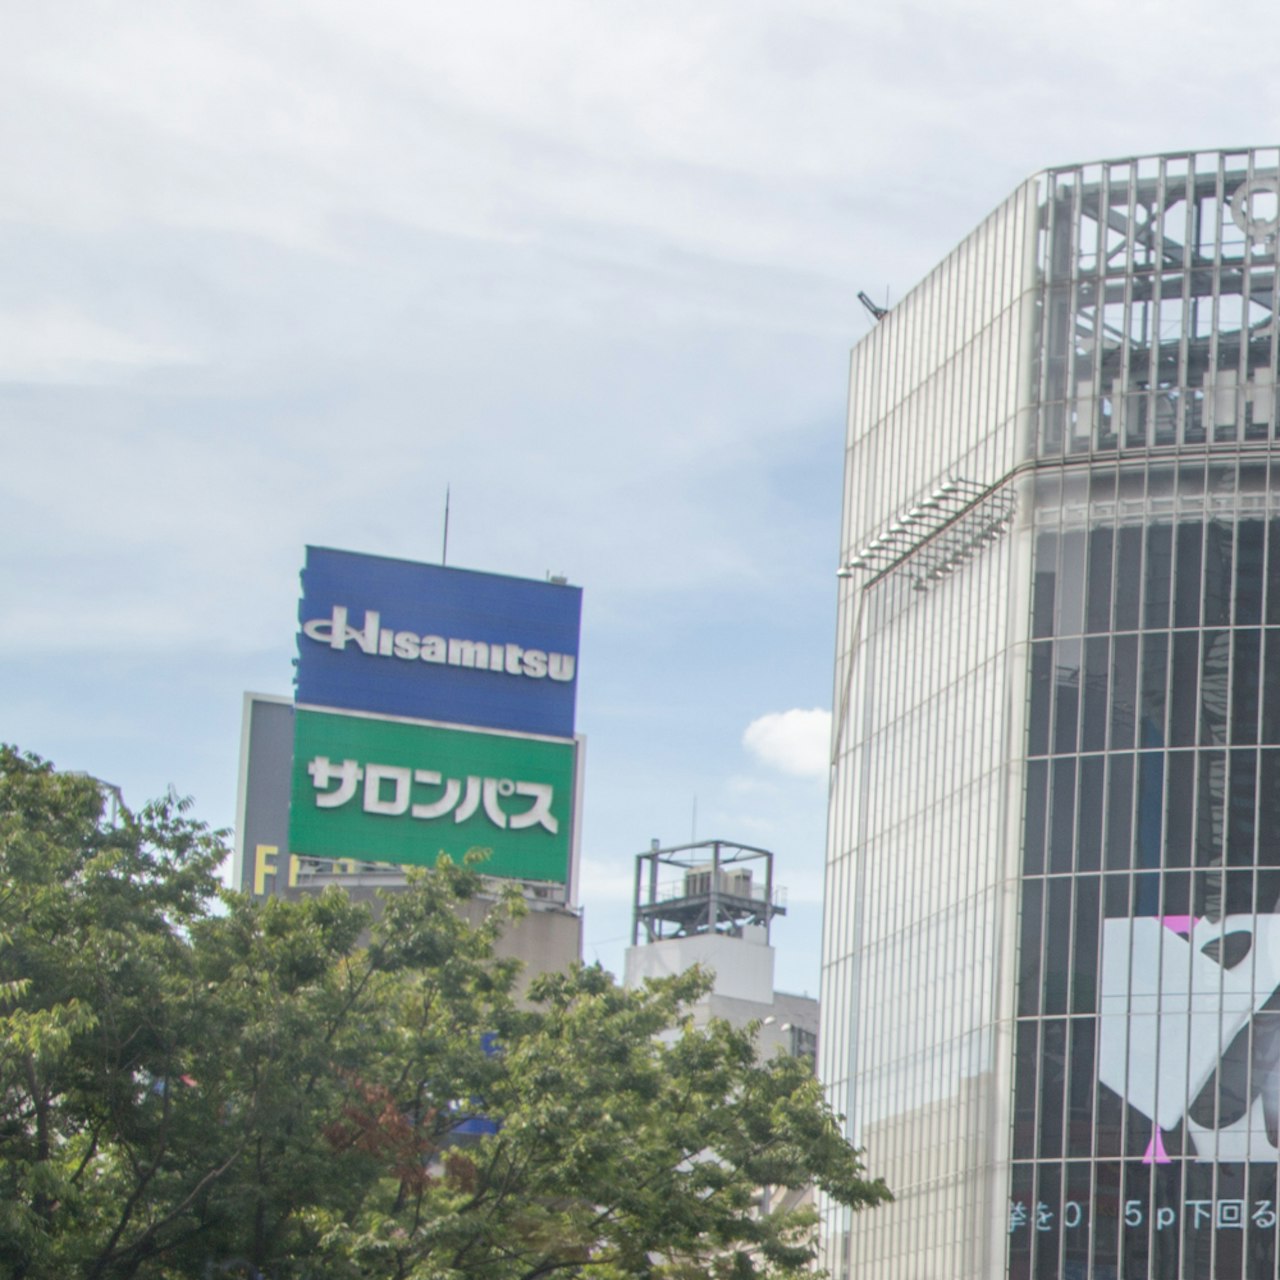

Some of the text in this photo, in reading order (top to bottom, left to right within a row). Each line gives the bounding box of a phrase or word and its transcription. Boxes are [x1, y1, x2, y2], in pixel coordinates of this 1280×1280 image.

[303, 605, 577, 683] Hisamitsu
[308, 755, 558, 835] サロンパス
